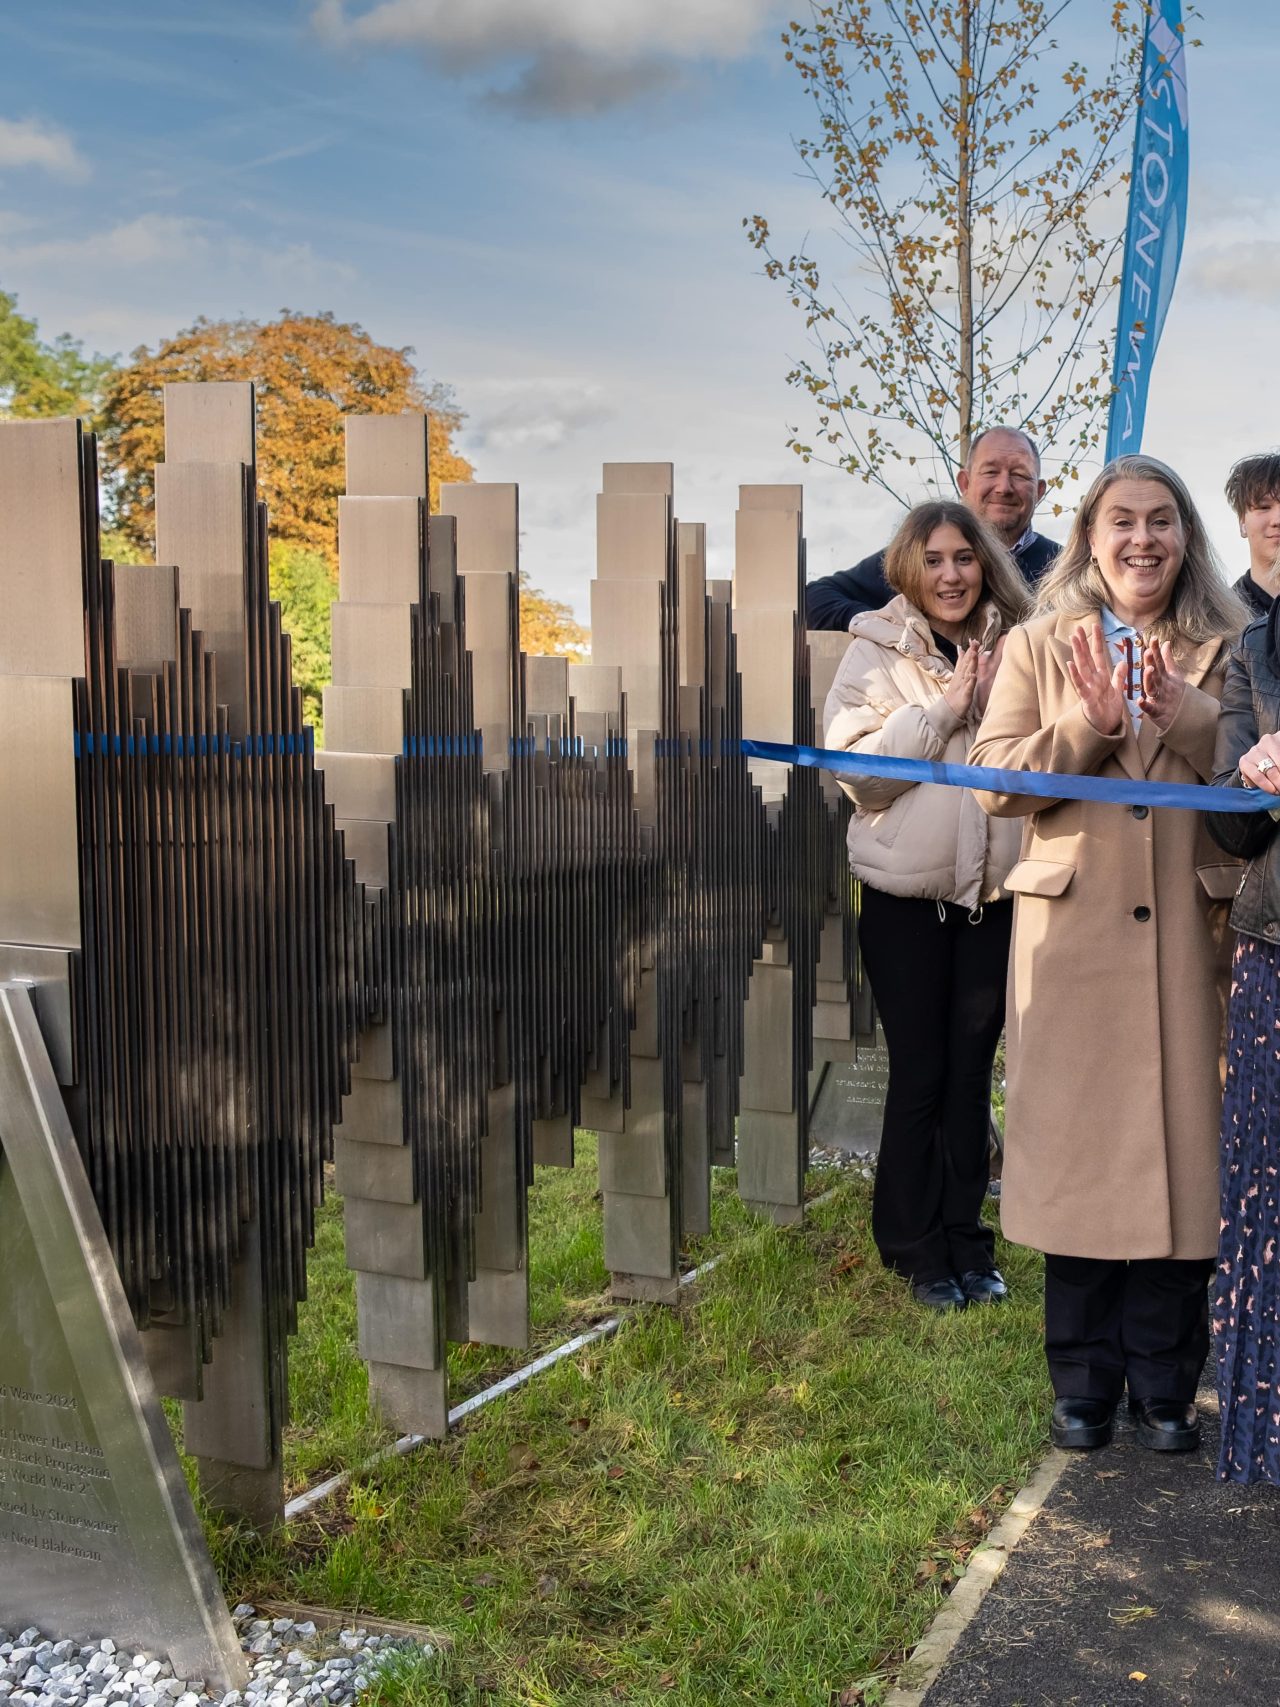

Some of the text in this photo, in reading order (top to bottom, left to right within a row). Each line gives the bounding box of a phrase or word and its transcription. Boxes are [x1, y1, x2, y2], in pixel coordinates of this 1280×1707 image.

[10, 1386, 42, 1404] Wave
[46, 1393, 78, 1411] 2024
[51, 1435, 71, 1452] the
[10, 1468, 46, 1487] World
[50, 1476, 75, 1493] War
[32, 1504, 46, 1523] by
[48, 1508, 119, 1535] Stonewater
[11, 1529, 38, 1549] Noel
[41, 1538, 102, 1563] Blakeman
